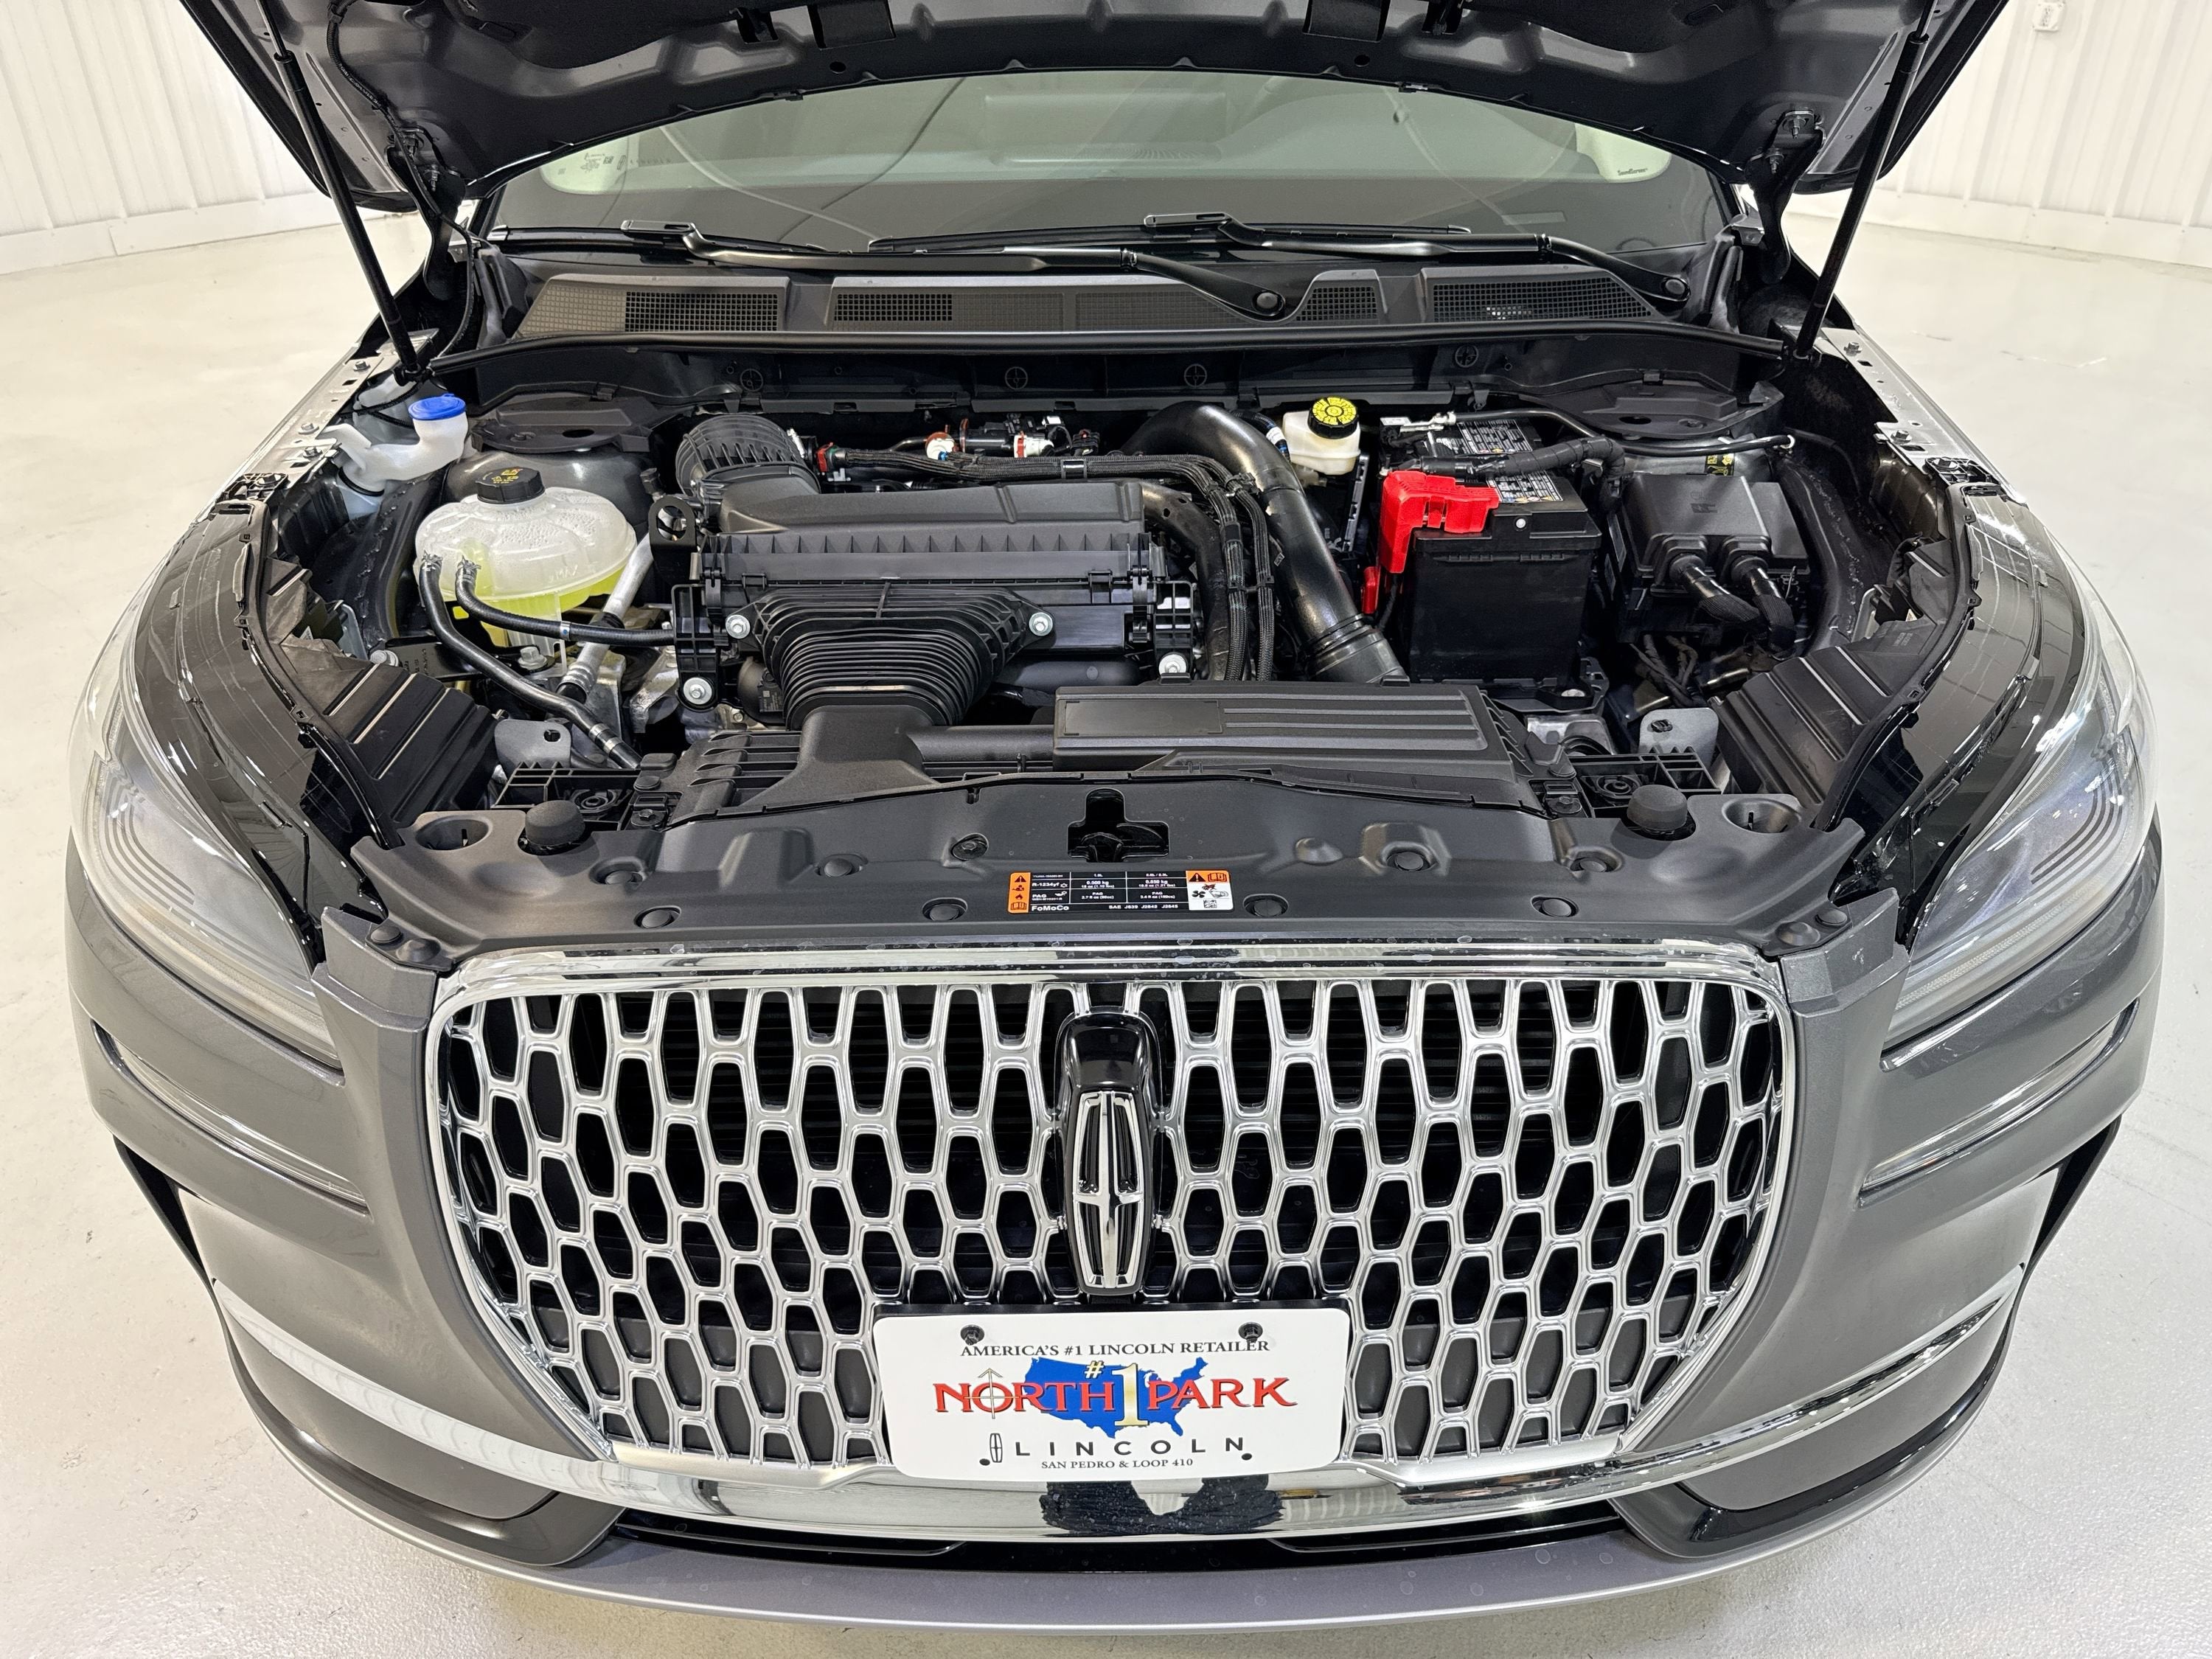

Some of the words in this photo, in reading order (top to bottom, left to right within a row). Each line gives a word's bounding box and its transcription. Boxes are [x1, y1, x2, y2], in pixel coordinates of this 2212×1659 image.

[960, 1344, 1060, 1356] AMERICA'S
[1064, 1344, 1082, 1356] #1
[1088, 1343, 1175, 1355] LINCOLN
[1180, 1340, 1270, 1353] RETAILER
[933, 1382, 1115, 1413] NORTH
[1147, 1377, 1298, 1411] PARK
[1015, 1436, 1244, 1456] LINCOLN
[1041, 1461, 1067, 1469] SAN
[1071, 1461, 1116, 1469] PEDRO
[1133, 1459, 1169, 1467] LOOP
[1172, 1458, 1193, 1466] 410
